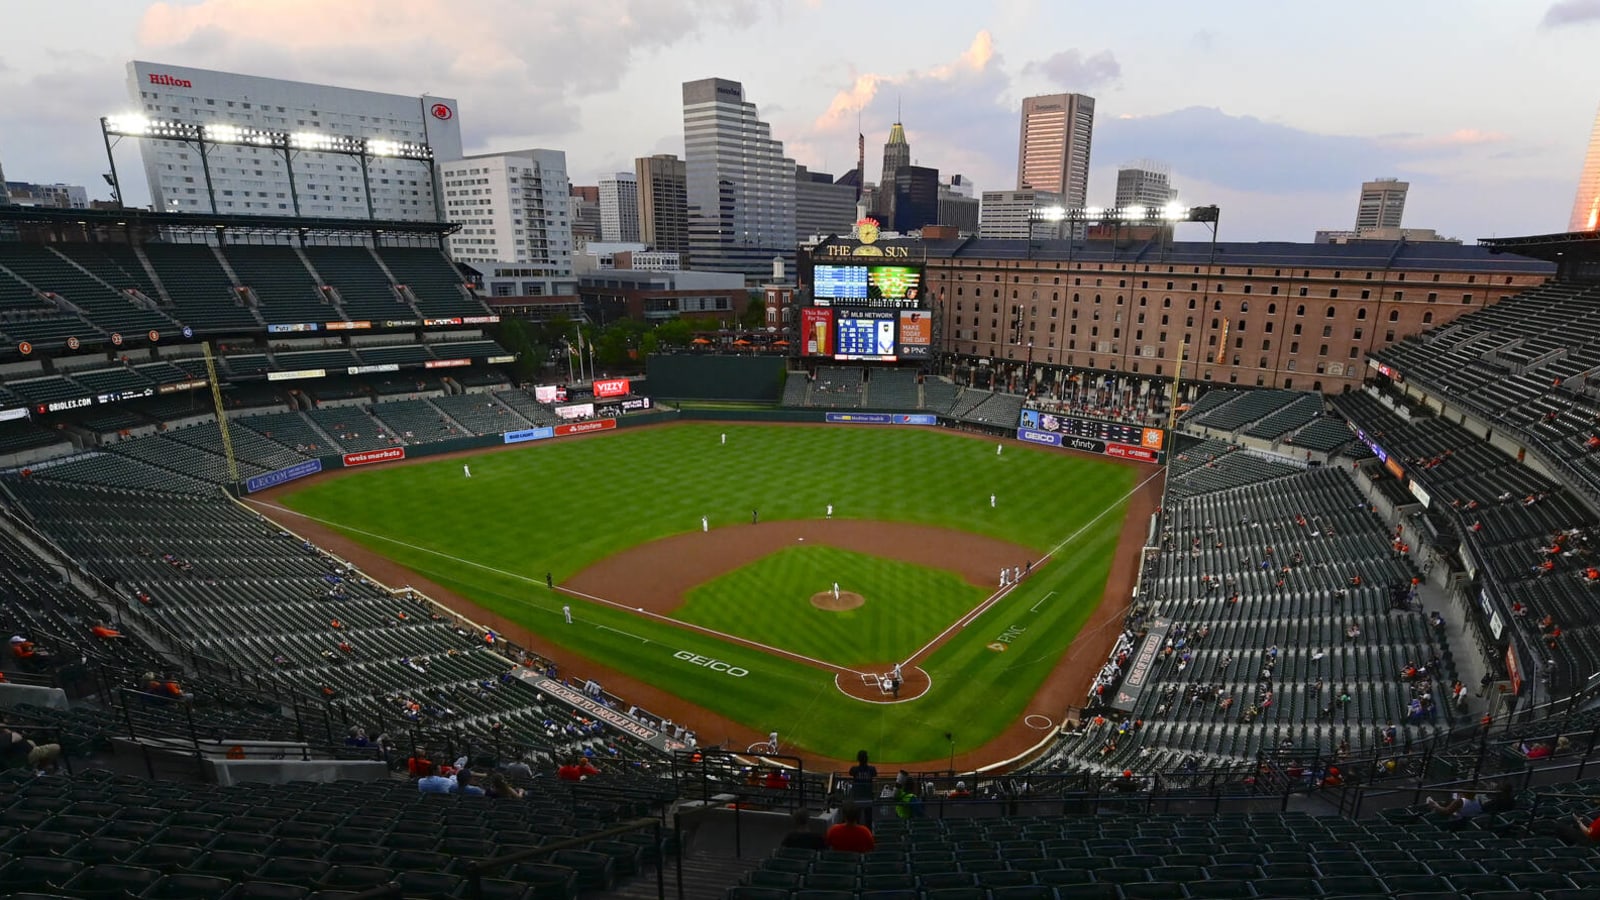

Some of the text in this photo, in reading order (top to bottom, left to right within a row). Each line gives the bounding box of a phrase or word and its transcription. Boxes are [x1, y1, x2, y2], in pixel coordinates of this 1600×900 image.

[149, 73, 192, 89] Hilton
[827, 245, 909, 258] THE SUN
[597, 381, 625, 391] VIZZY
[48, 397, 92, 412] ORIOLES.COM
[1024, 431, 1055, 442] GEICO
[1070, 438, 1096, 451] xfinity
[347, 450, 400, 463] weis markets
[251, 470, 288, 489] LECOM
[997, 624, 1027, 644] PNC
[672, 649, 750, 678] GEICO
[541, 680, 654, 738] WELCOME TO ORIOLE PARK
